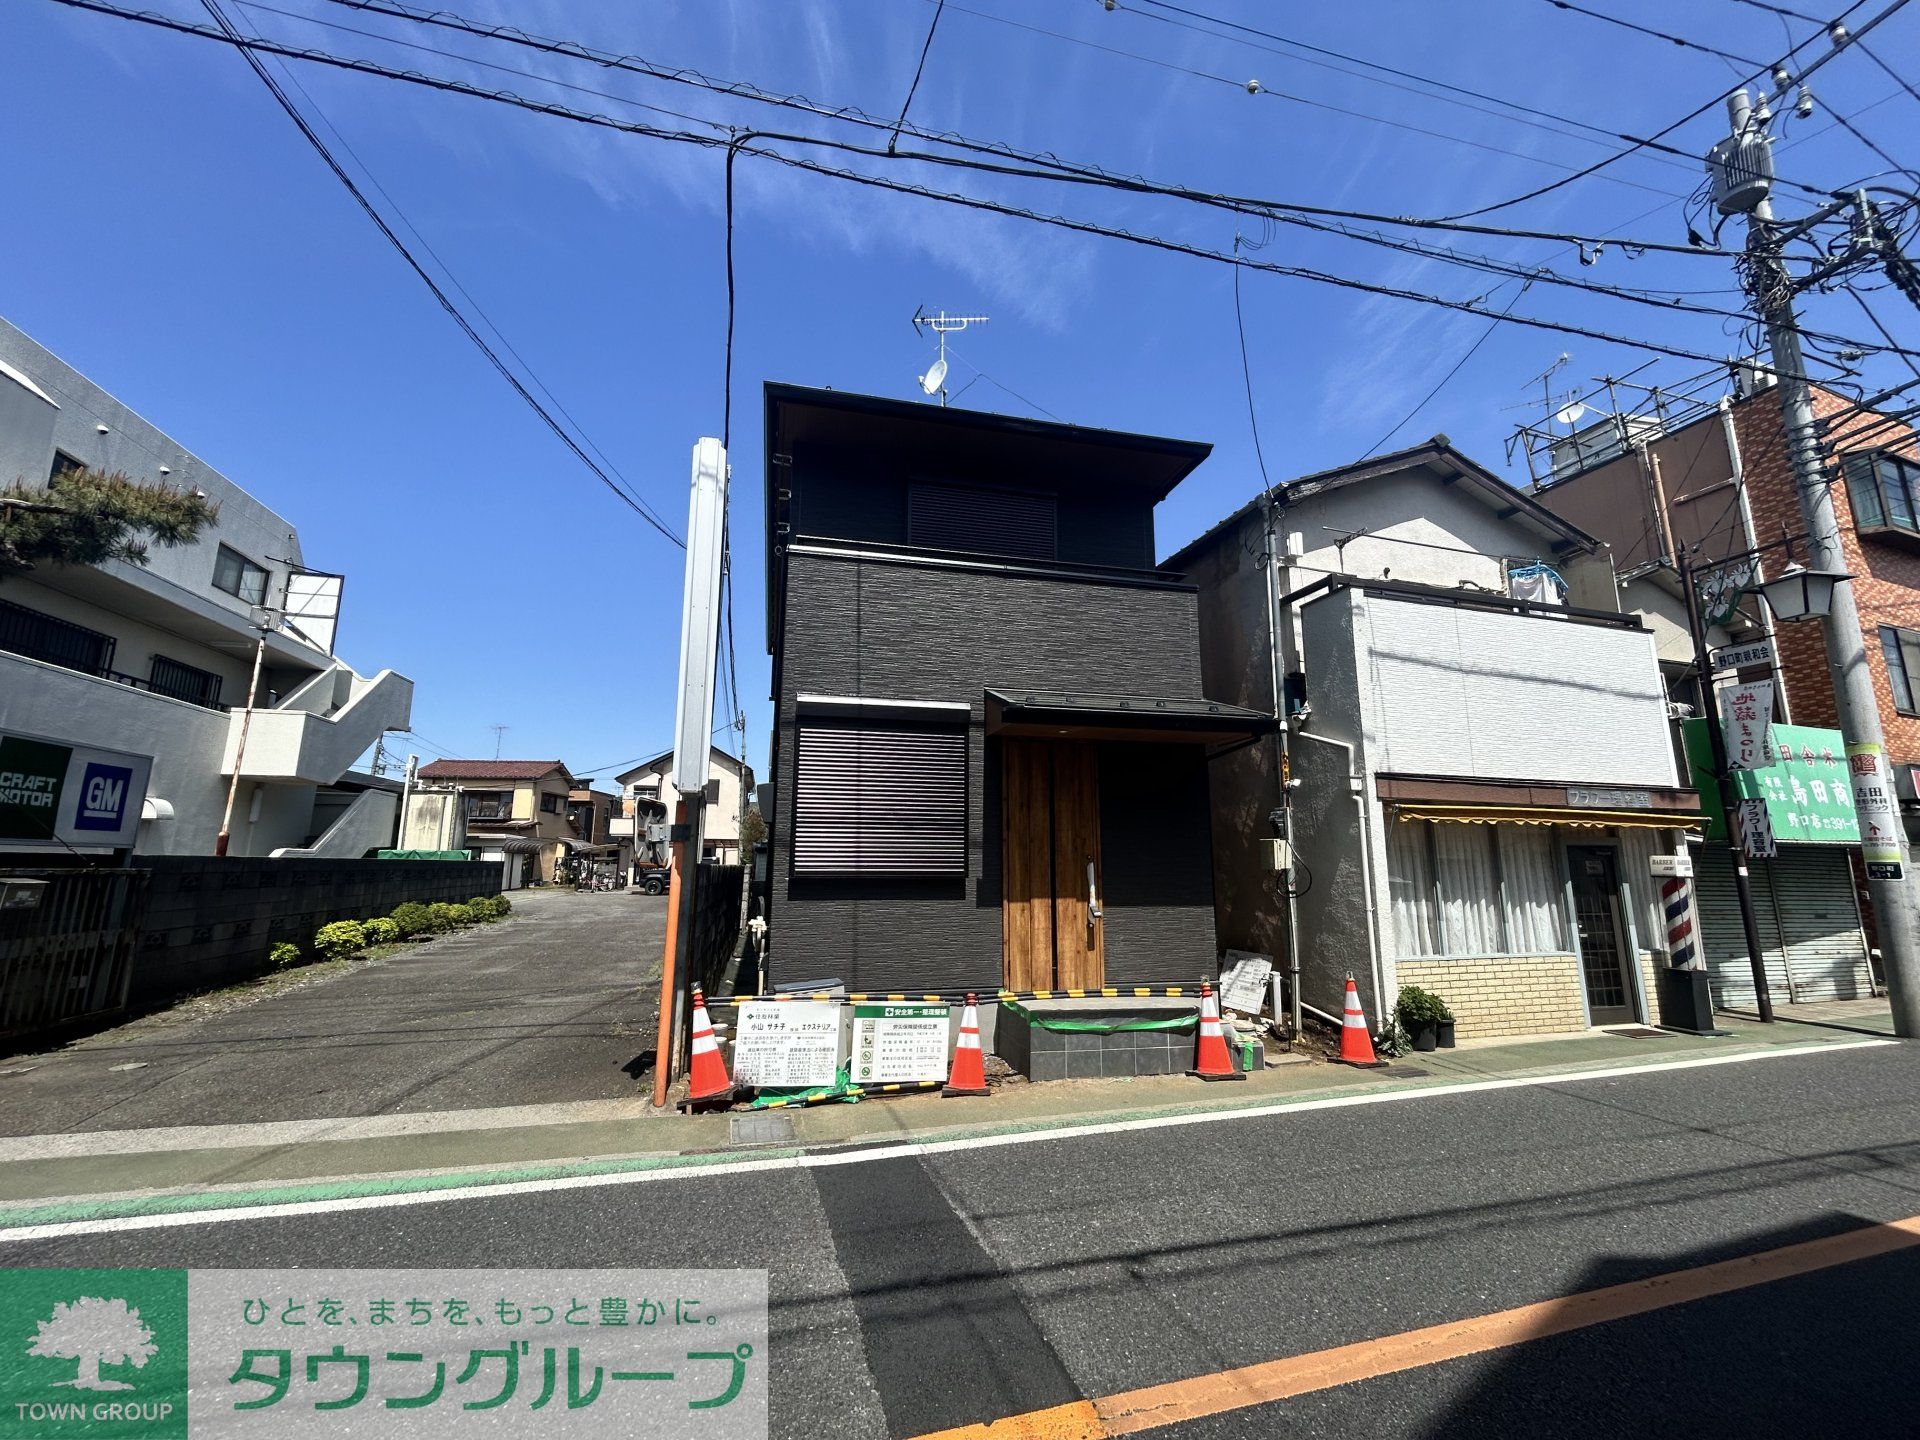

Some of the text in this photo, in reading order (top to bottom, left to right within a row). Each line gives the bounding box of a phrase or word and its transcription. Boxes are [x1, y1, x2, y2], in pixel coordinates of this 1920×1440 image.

[1, 772, 57, 791] CRAFT
[0, 788, 53, 807] MOTOR
[86, 777, 124, 812] GM
[1856, 787, 1882, 797] 吉田
